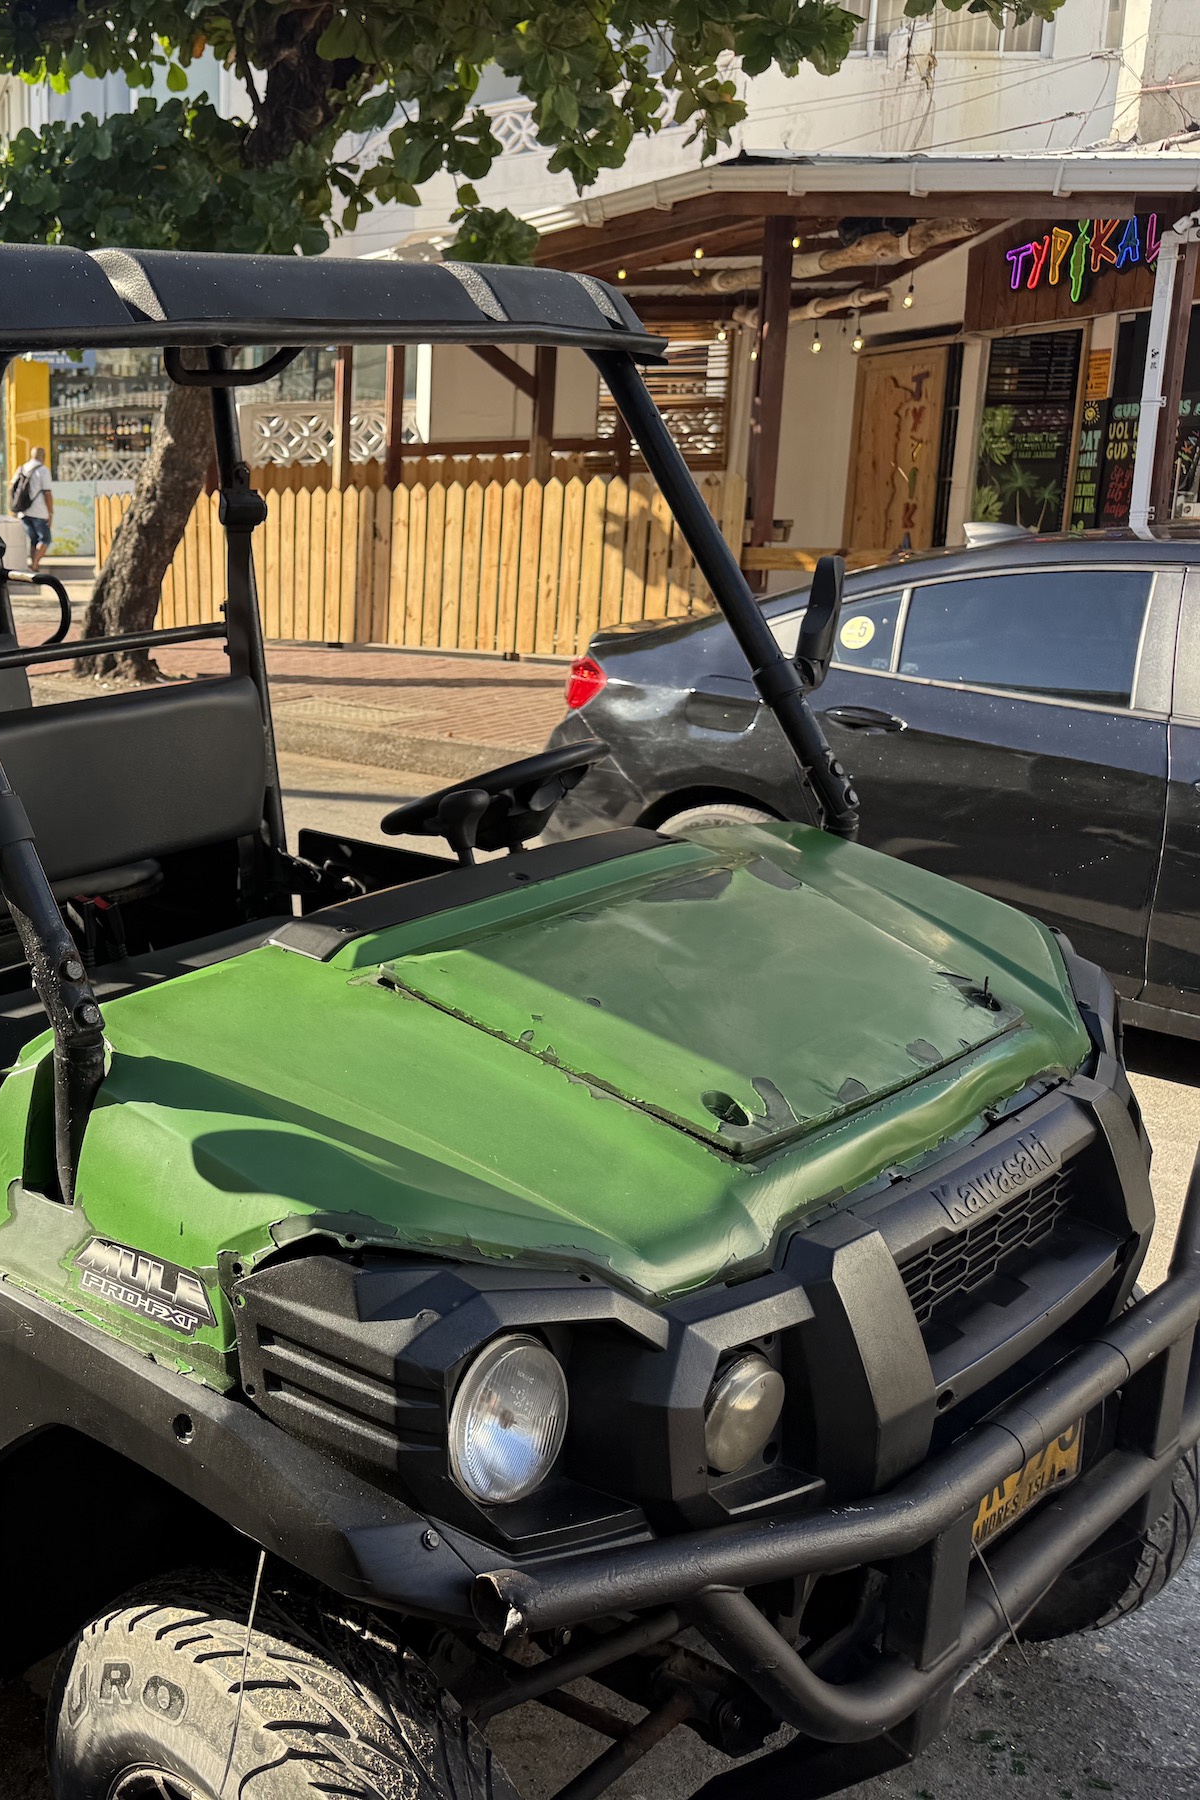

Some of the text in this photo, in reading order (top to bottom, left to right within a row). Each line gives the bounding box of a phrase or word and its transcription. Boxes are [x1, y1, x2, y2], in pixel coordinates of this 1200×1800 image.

[929, 1130, 1058, 1224] Kawasaki
[76, 1238, 211, 1320] MULE
[82, 1270, 198, 1330] PRO-FXT
